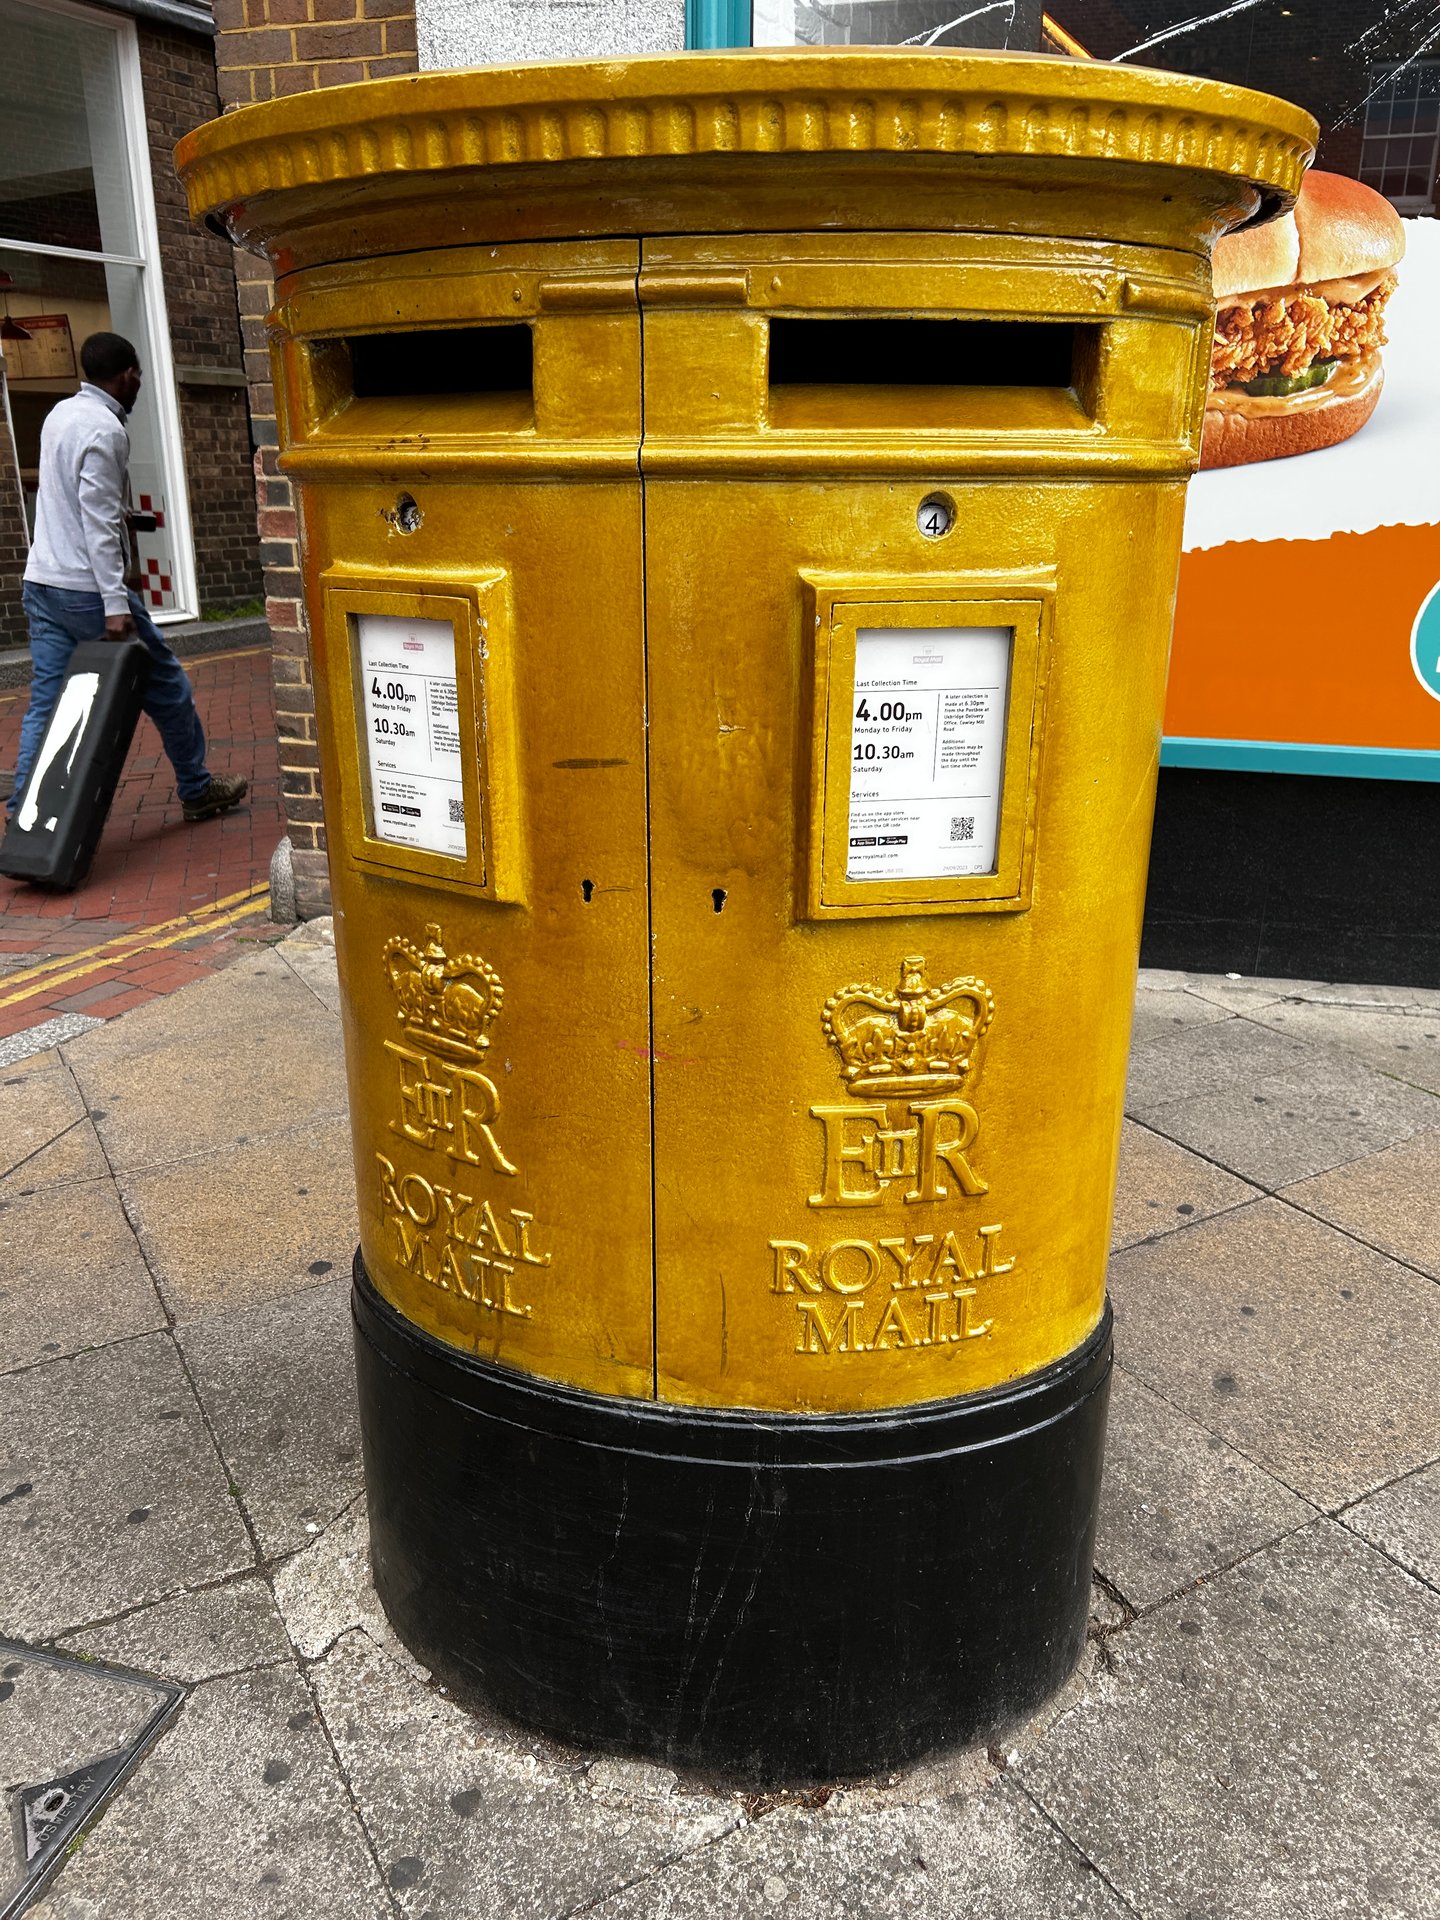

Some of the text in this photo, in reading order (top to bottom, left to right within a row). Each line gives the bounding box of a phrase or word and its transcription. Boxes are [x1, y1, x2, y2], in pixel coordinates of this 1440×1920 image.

[925, 513, 940, 534] 4
[372, 677, 416, 703] 4.00pm
[397, 705, 410, 713] Friday
[856, 699, 922, 722] 4.00pm
[374, 718, 415, 737] 10.30am
[376, 738, 395, 746] Saturday
[854, 744, 914, 760] 10.30am
[376, 1152, 552, 1267] ROYAL
[395, 1216, 532, 1320] MAIL
[768, 1224, 1015, 1295] ROYAL
[796, 1288, 994, 1354] MAIL
[38, 1776, 95, 1842] OSWESTRY
